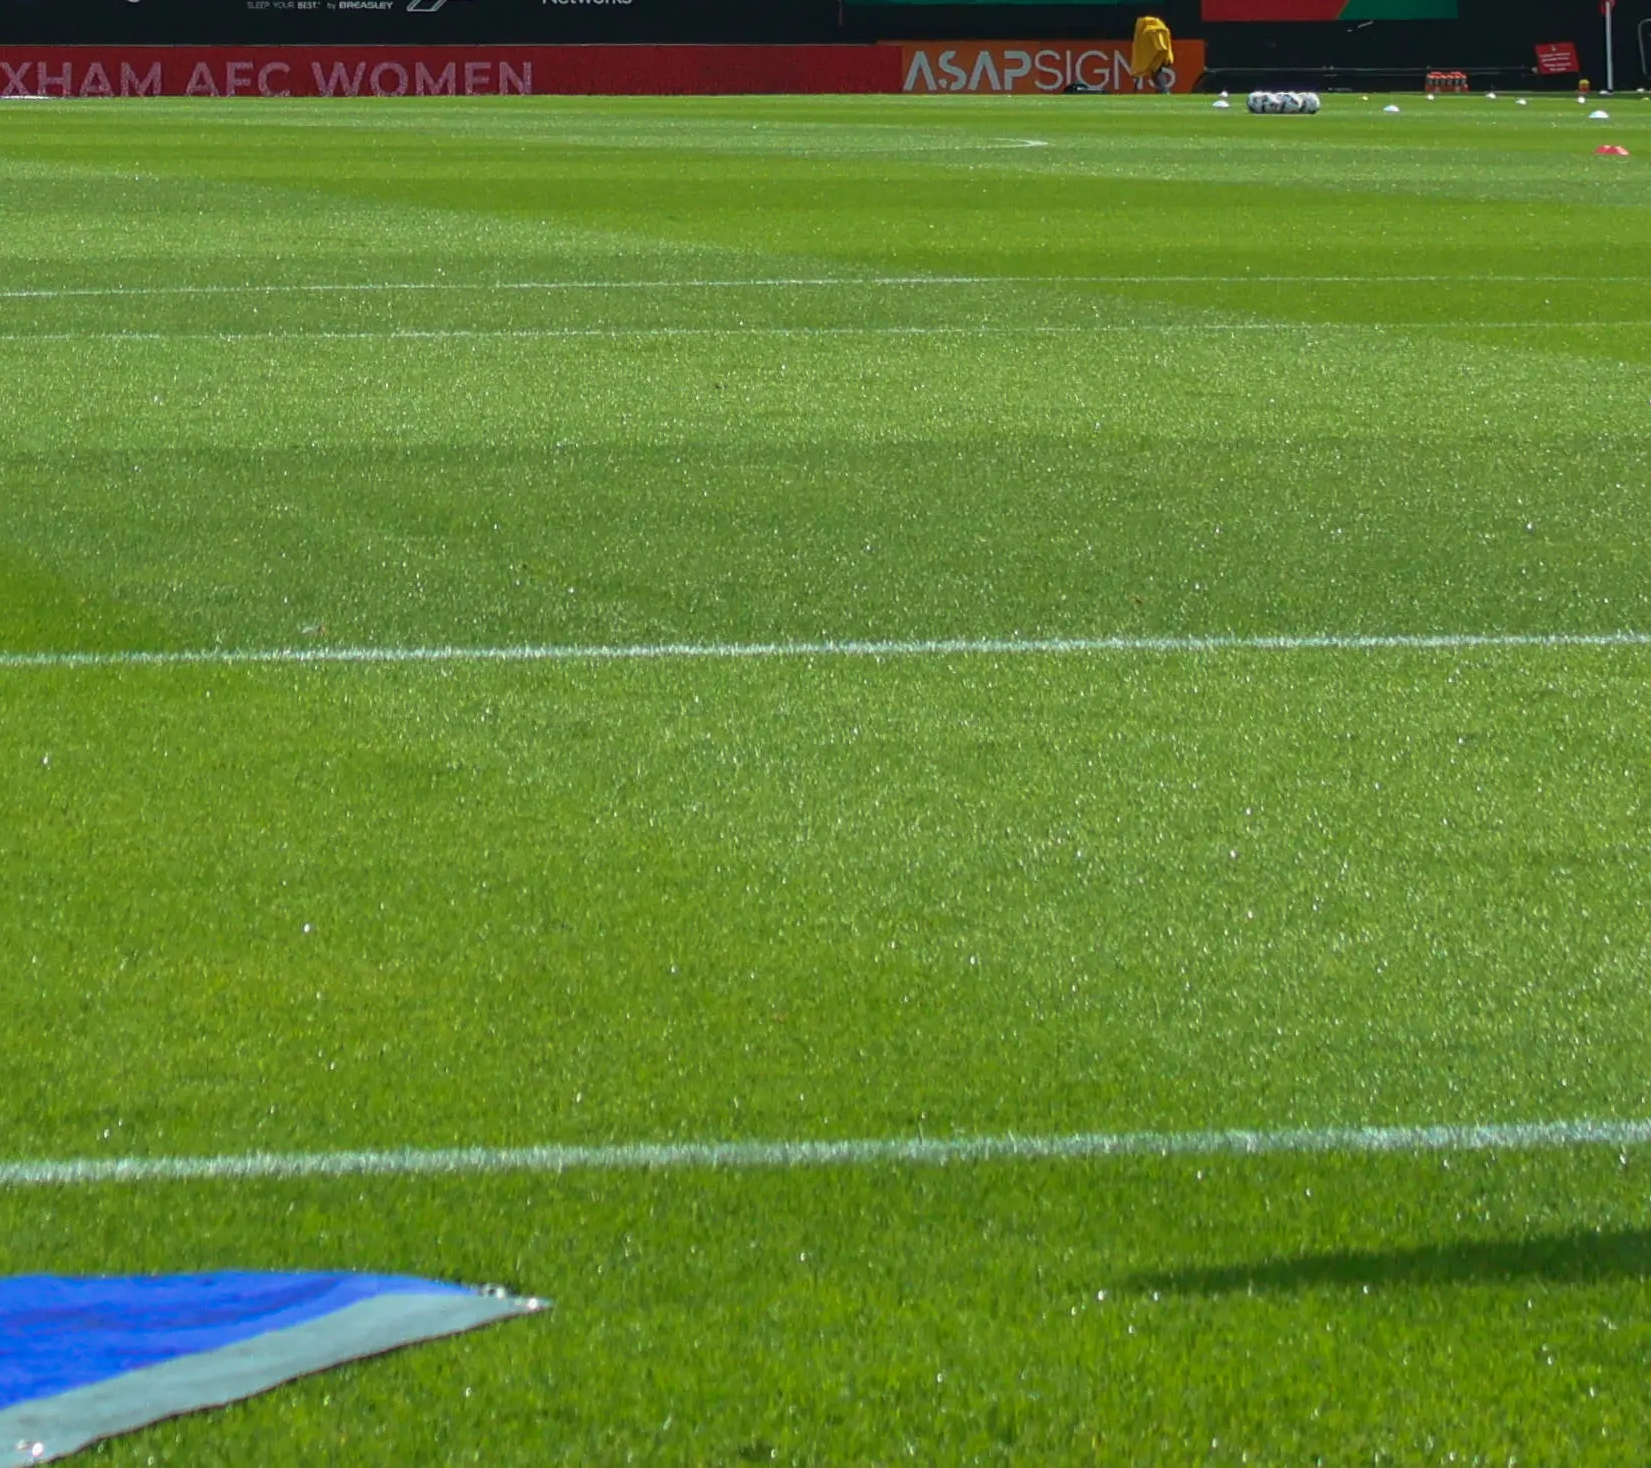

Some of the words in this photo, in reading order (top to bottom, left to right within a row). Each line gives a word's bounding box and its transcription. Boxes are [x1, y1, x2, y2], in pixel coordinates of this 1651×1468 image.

[273, 1, 295, 9] YOUR
[327, 1, 337, 11] by
[339, 1, 394, 9] BREASLEY
[186, 61, 291, 97] AFC
[310, 61, 532, 97] WOMEN
